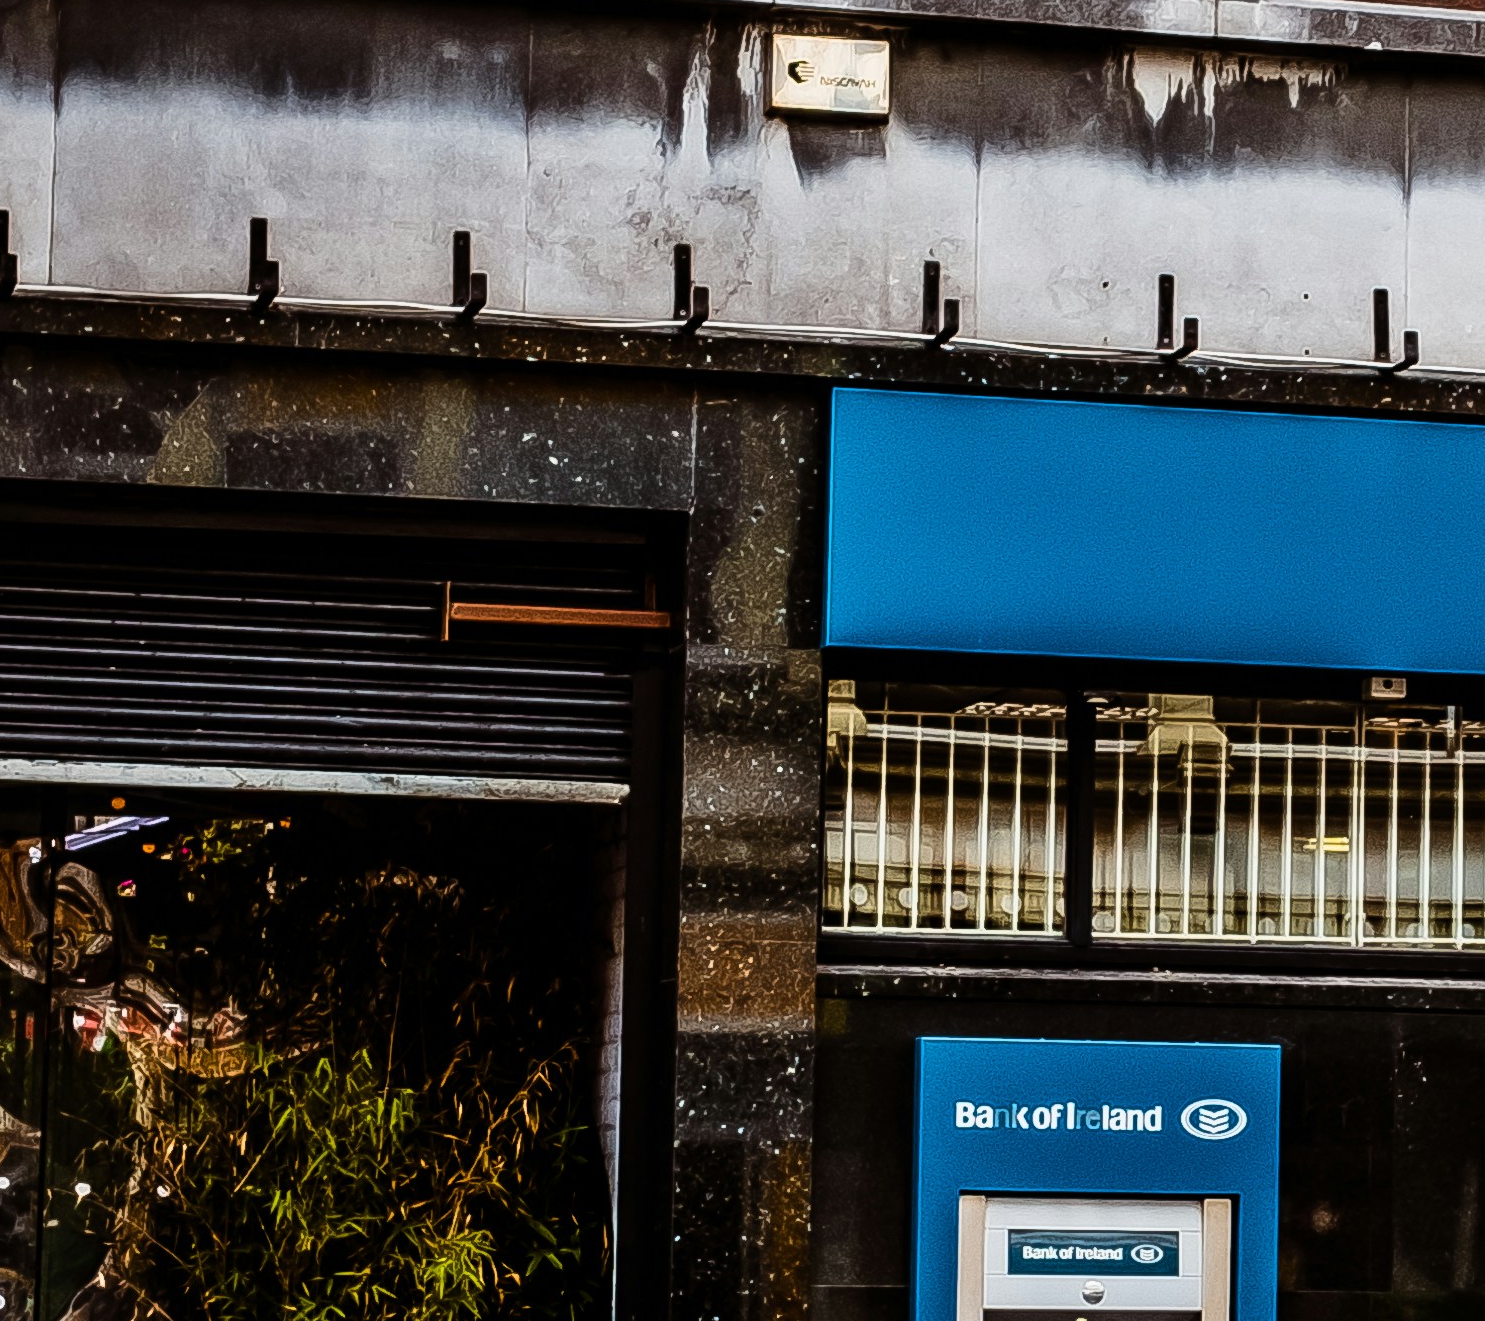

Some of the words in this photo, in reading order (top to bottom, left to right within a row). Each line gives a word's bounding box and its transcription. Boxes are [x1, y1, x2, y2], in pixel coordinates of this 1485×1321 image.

[955, 1101, 1030, 1130] Bank
[1032, 1103, 1064, 1131] of
[1066, 1101, 1162, 1132] Ireland
[1022, 1245, 1058, 1260] Bank
[1059, 1246, 1074, 1261] of
[1075, 1245, 1123, 1261] Ireland
